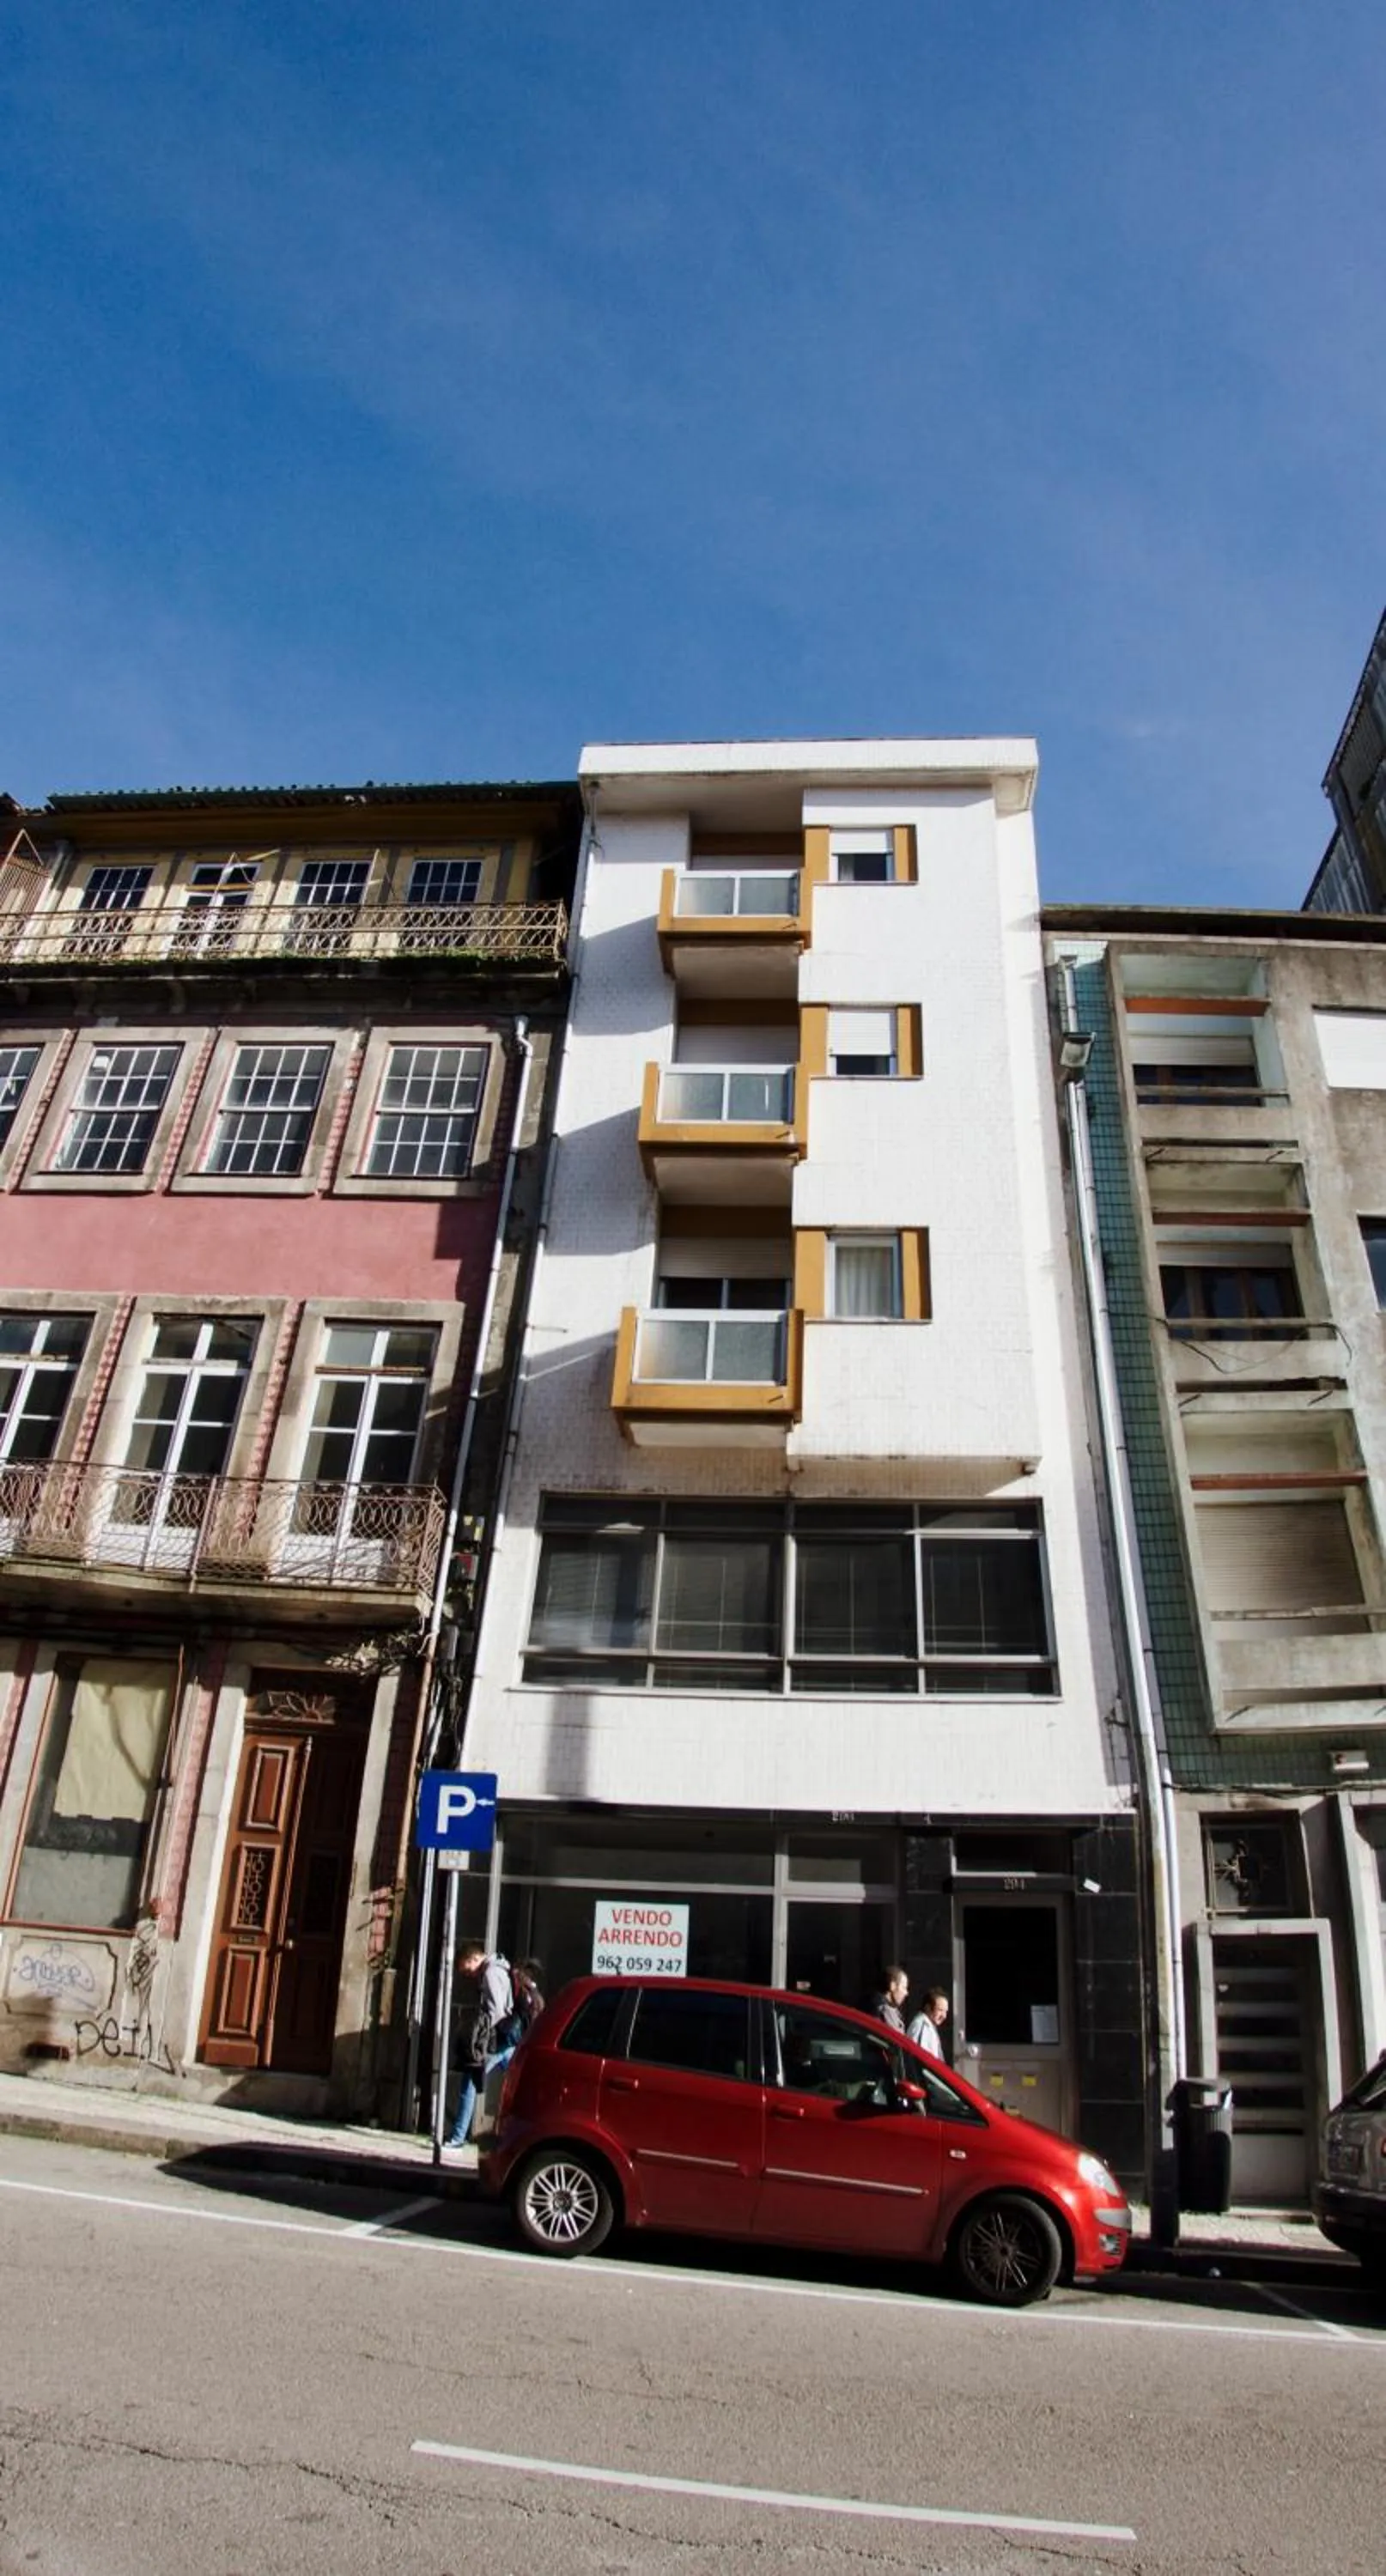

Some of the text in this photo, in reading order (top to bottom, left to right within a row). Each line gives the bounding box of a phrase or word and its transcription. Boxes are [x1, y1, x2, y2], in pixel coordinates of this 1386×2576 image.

[436, 1785, 477, 1834] P
[611, 1909, 672, 1926] VENDO
[598, 1928, 683, 1947] ARRENDO
[597, 1955, 682, 1973] 962 059 247
